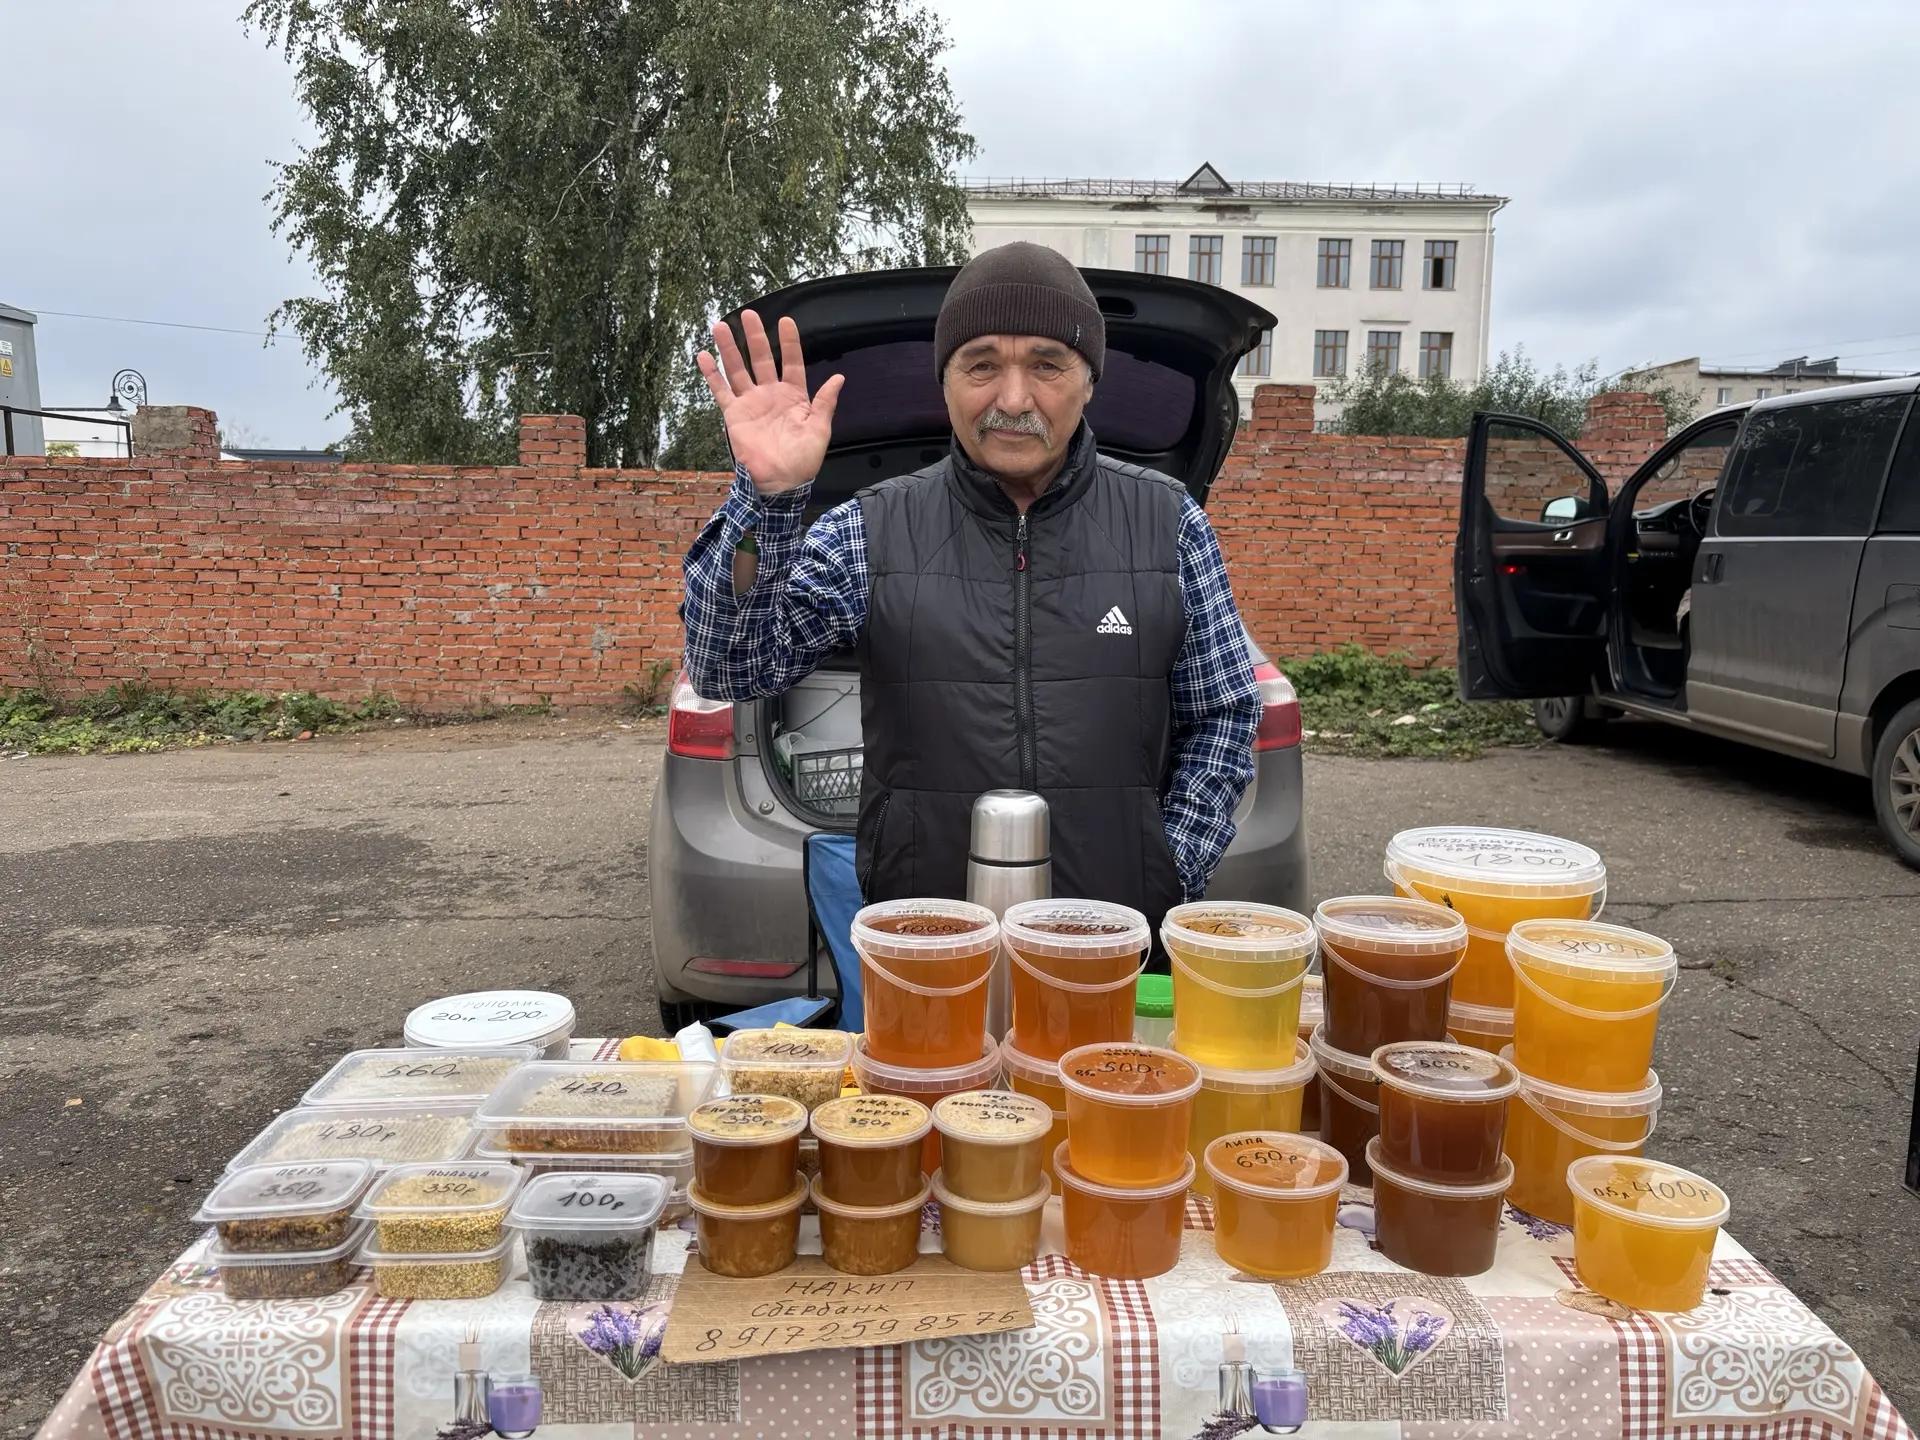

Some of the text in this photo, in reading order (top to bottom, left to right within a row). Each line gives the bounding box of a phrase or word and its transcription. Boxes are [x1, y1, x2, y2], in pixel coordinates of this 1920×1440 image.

[1096, 622, 1133, 636] adidas
[761, 1043, 818, 1058] 100р
[978, 1110, 1025, 1124] 350р
[422, 1182, 478, 1196] 350р
[557, 1191, 625, 1211] 100р
